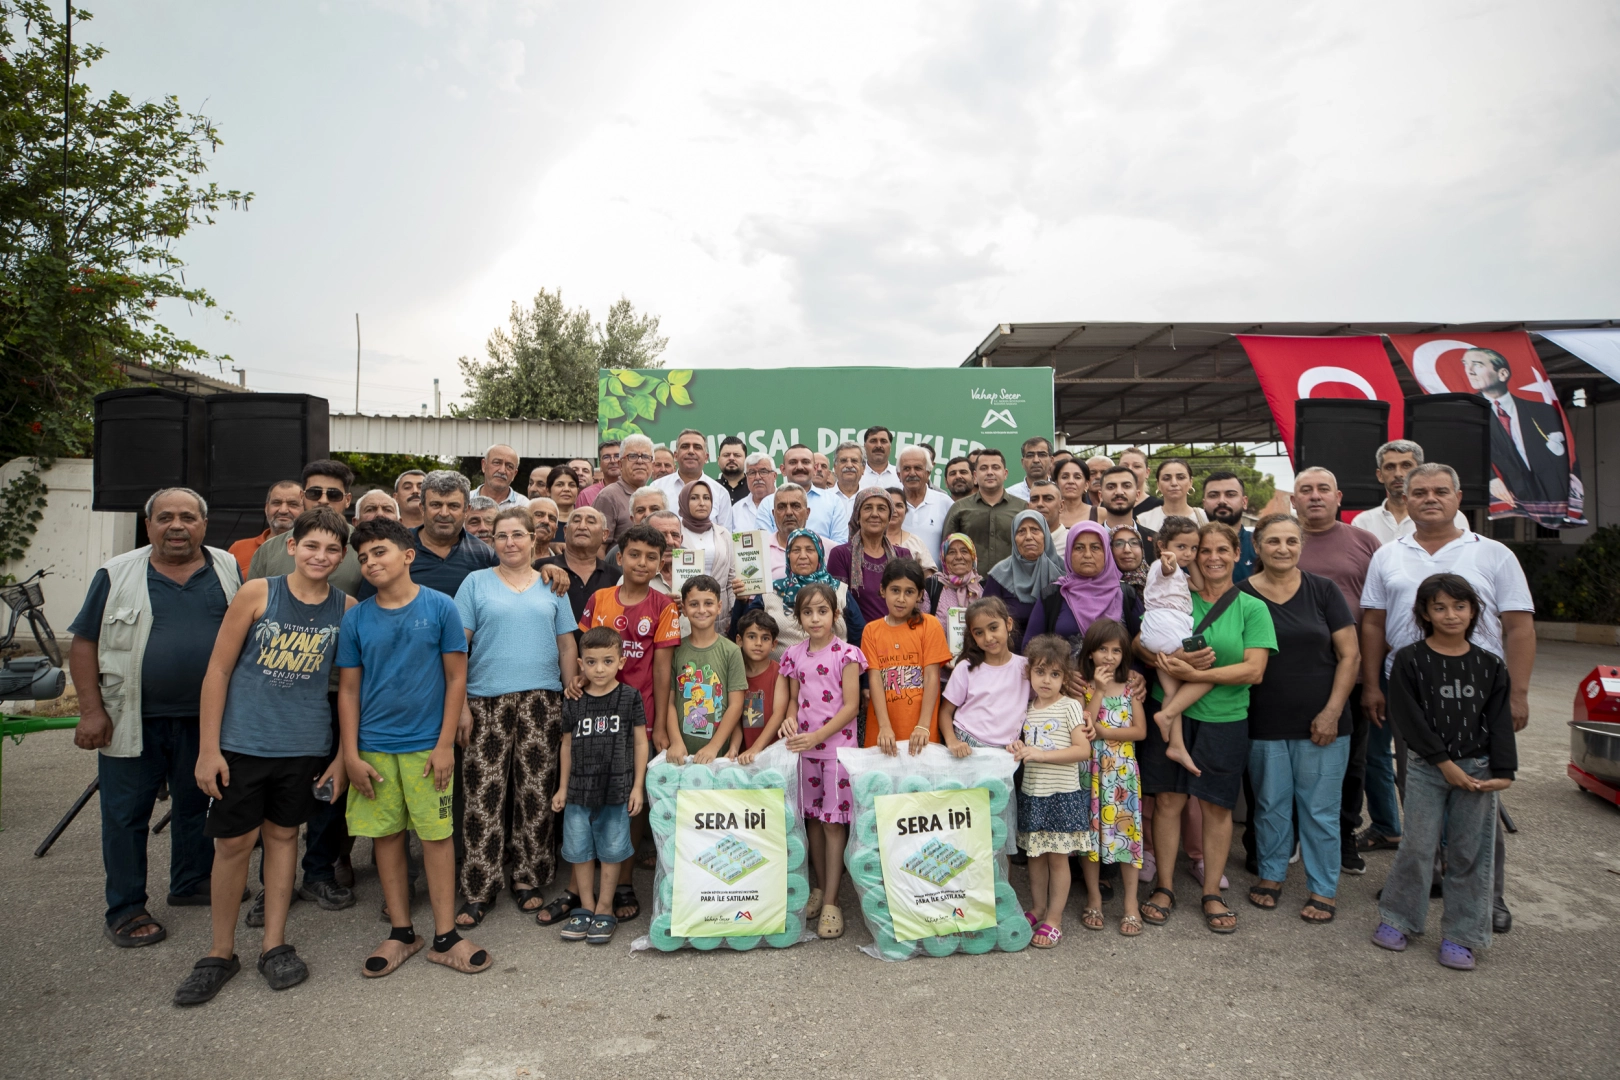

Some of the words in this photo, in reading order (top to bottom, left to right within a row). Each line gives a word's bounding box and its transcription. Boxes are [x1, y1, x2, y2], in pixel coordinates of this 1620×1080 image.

[971, 387, 998, 405] Vahap
[284, 623, 319, 634] ULTIMATE
[270, 631, 324, 653] WAVE
[257, 647, 324, 673] HUNTER
[272, 670, 301, 680] ENJOY
[1440, 678, 1475, 699] alo
[694, 812, 739, 830] SERA
[744, 808, 766, 830] İPİ
[896, 813, 943, 836] SERA
[948, 806, 972, 830] İPİ
[716, 894, 726, 902] İLE
[726, 894, 759, 902] SATILAMAZ
